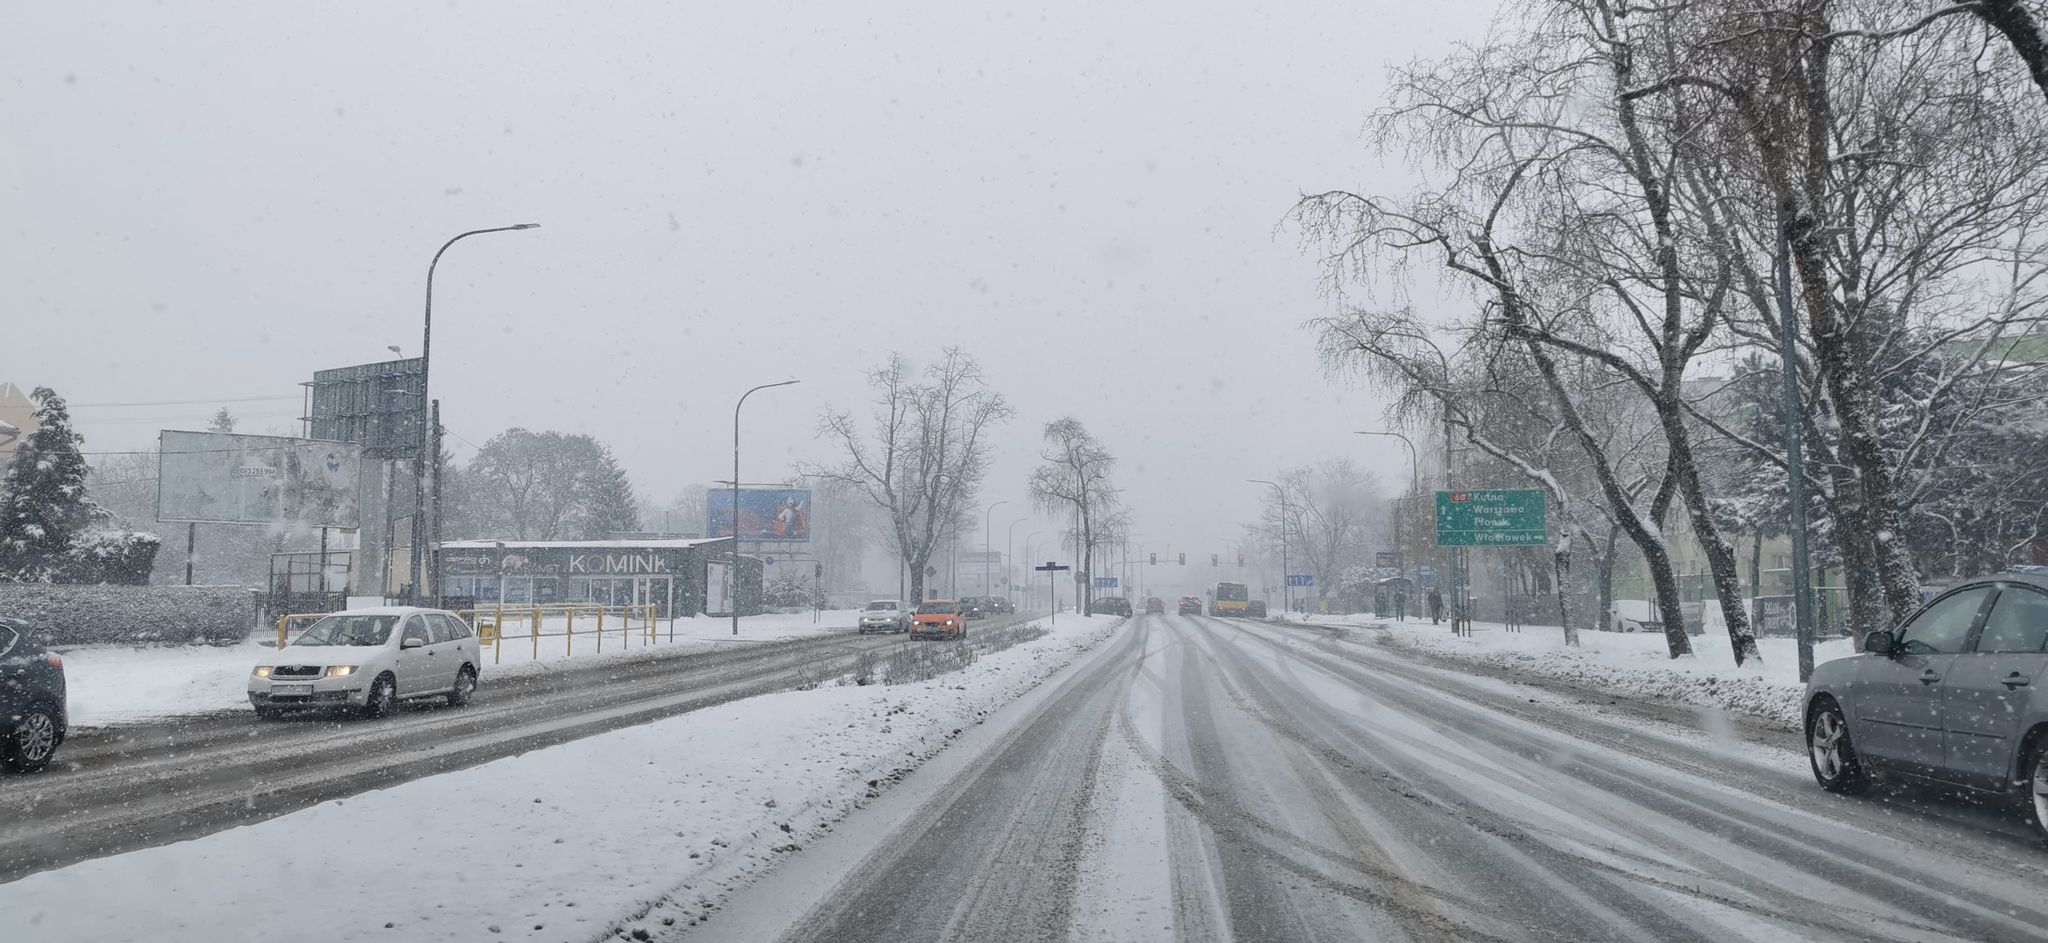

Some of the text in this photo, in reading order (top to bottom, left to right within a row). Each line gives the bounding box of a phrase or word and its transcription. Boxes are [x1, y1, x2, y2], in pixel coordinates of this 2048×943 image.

[1473, 492, 1504, 501] Kutno
[1473, 505, 1525, 514] Warszawa
[1474, 532, 1533, 542] Włocławek
